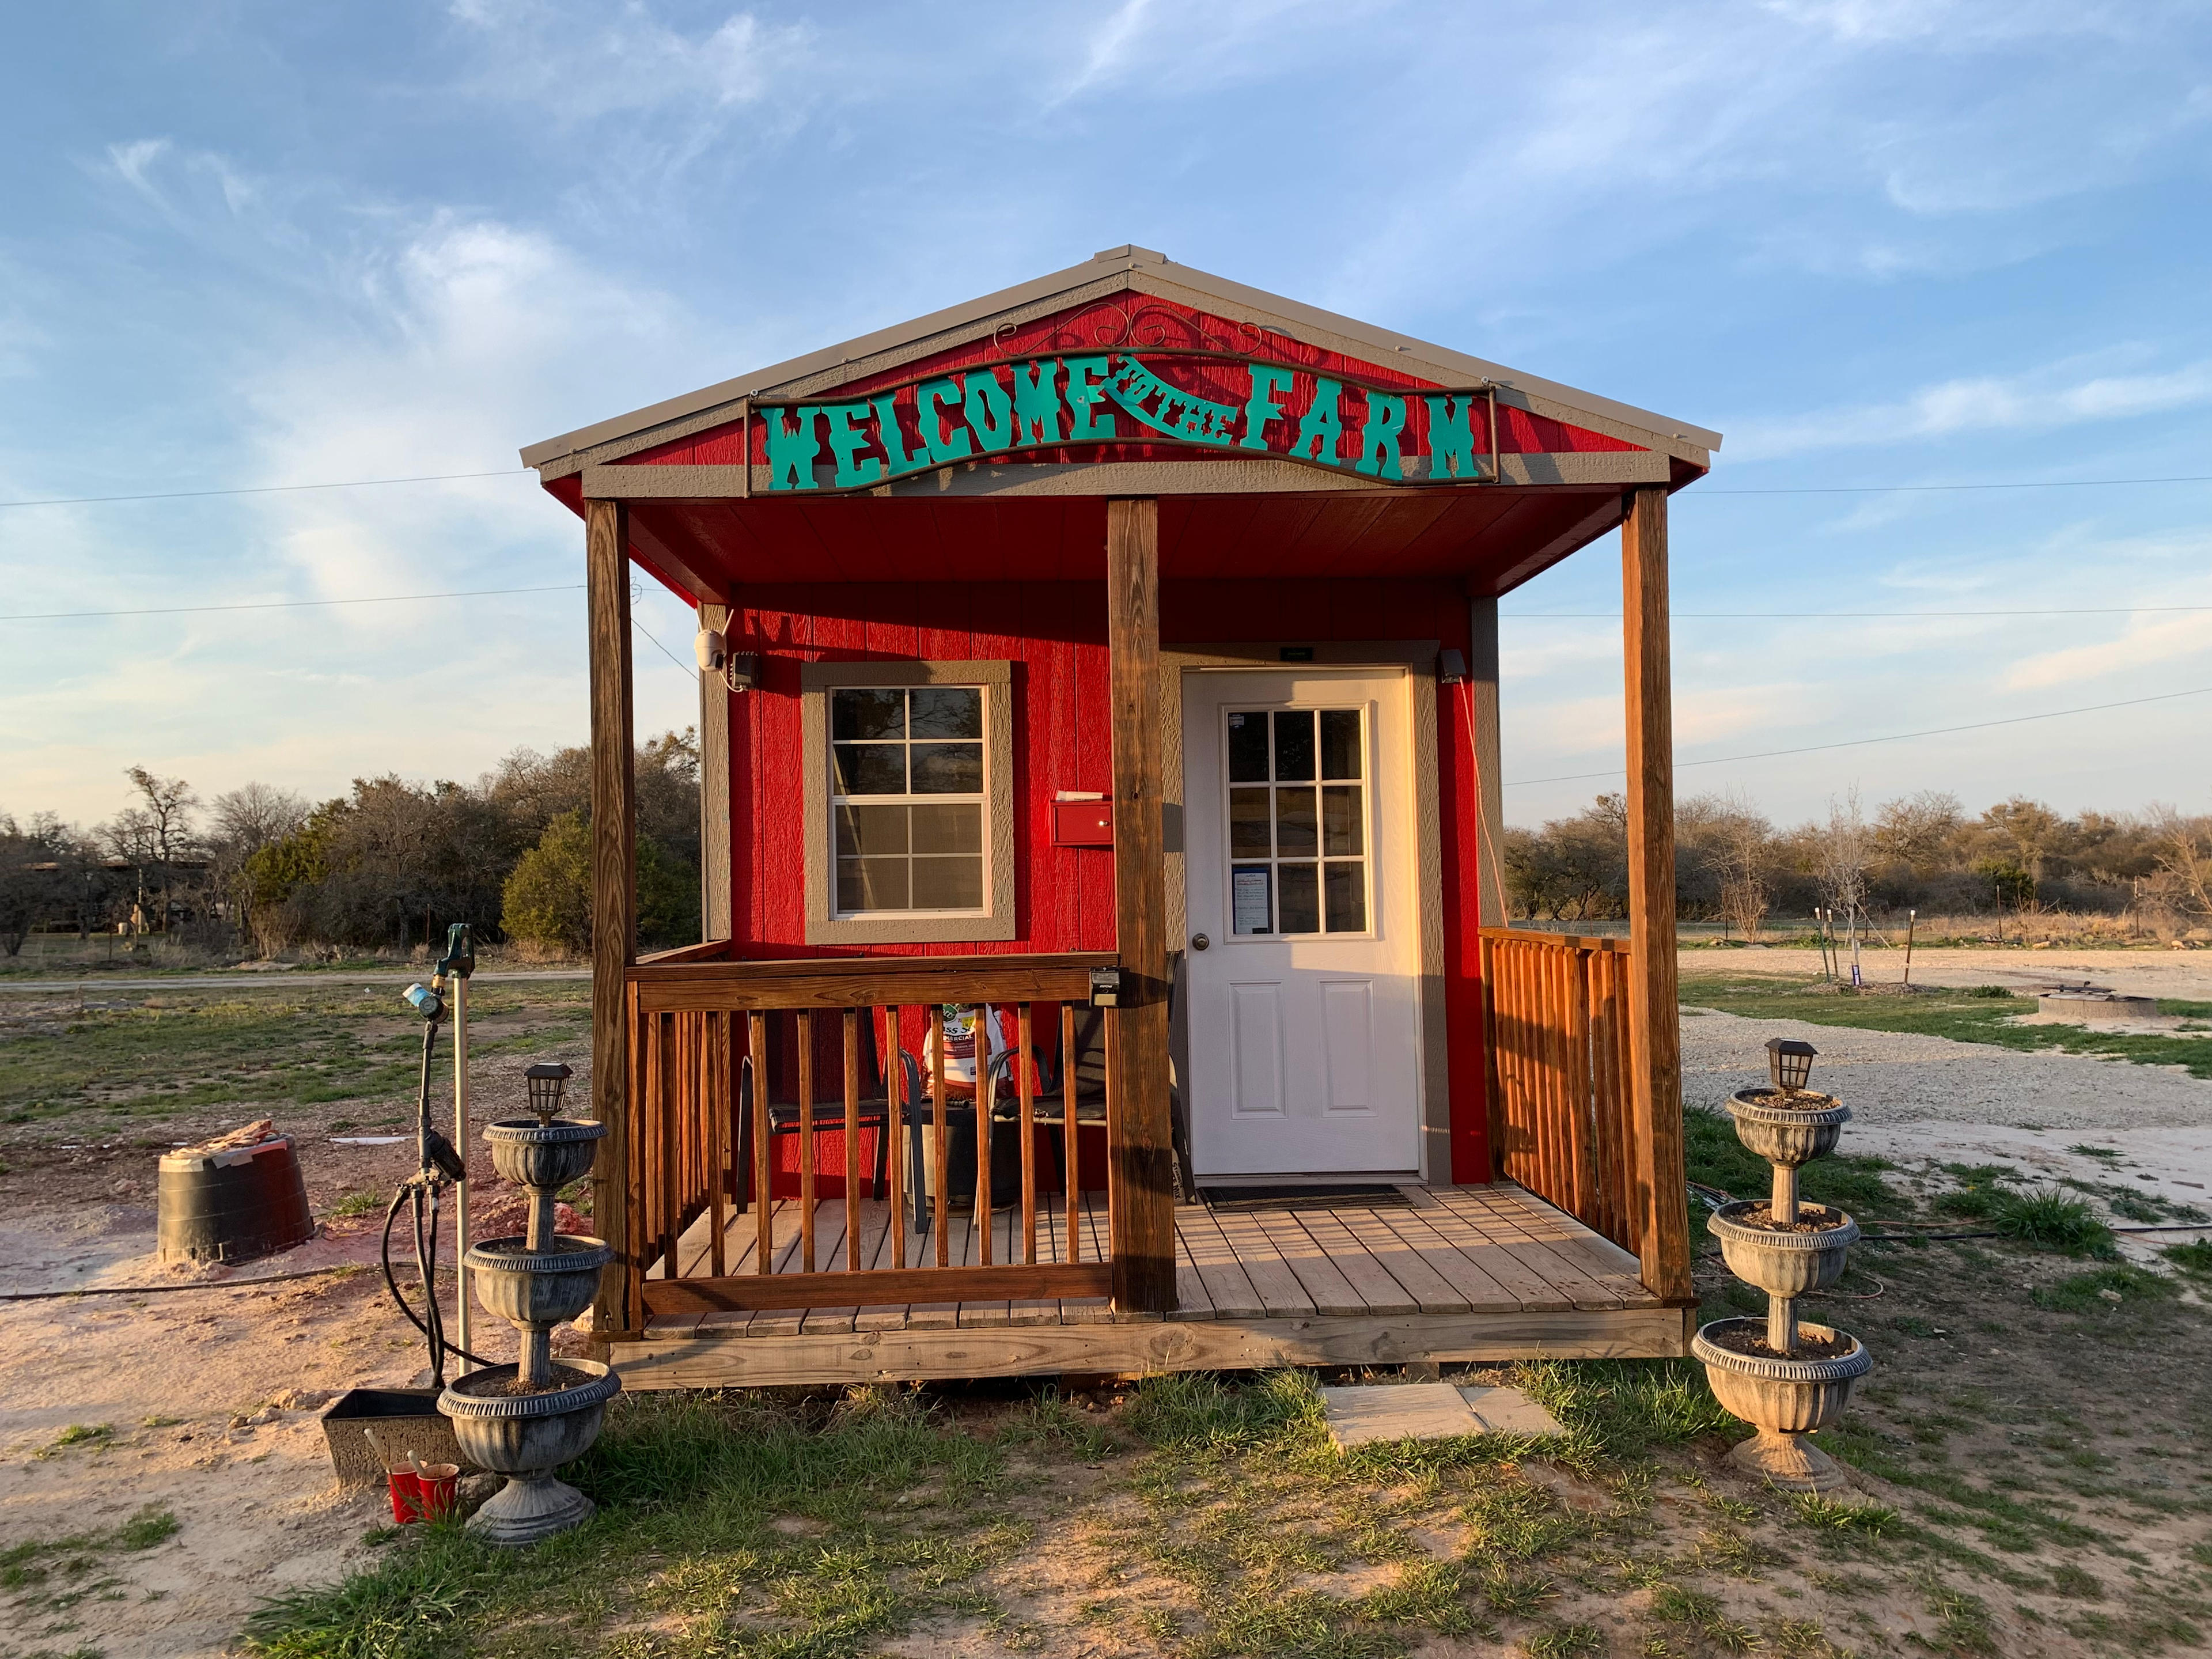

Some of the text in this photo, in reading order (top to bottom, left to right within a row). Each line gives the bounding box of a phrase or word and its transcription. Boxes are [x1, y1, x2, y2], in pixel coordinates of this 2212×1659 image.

[760, 355, 1479, 490] WELCOME TO THE FARM
